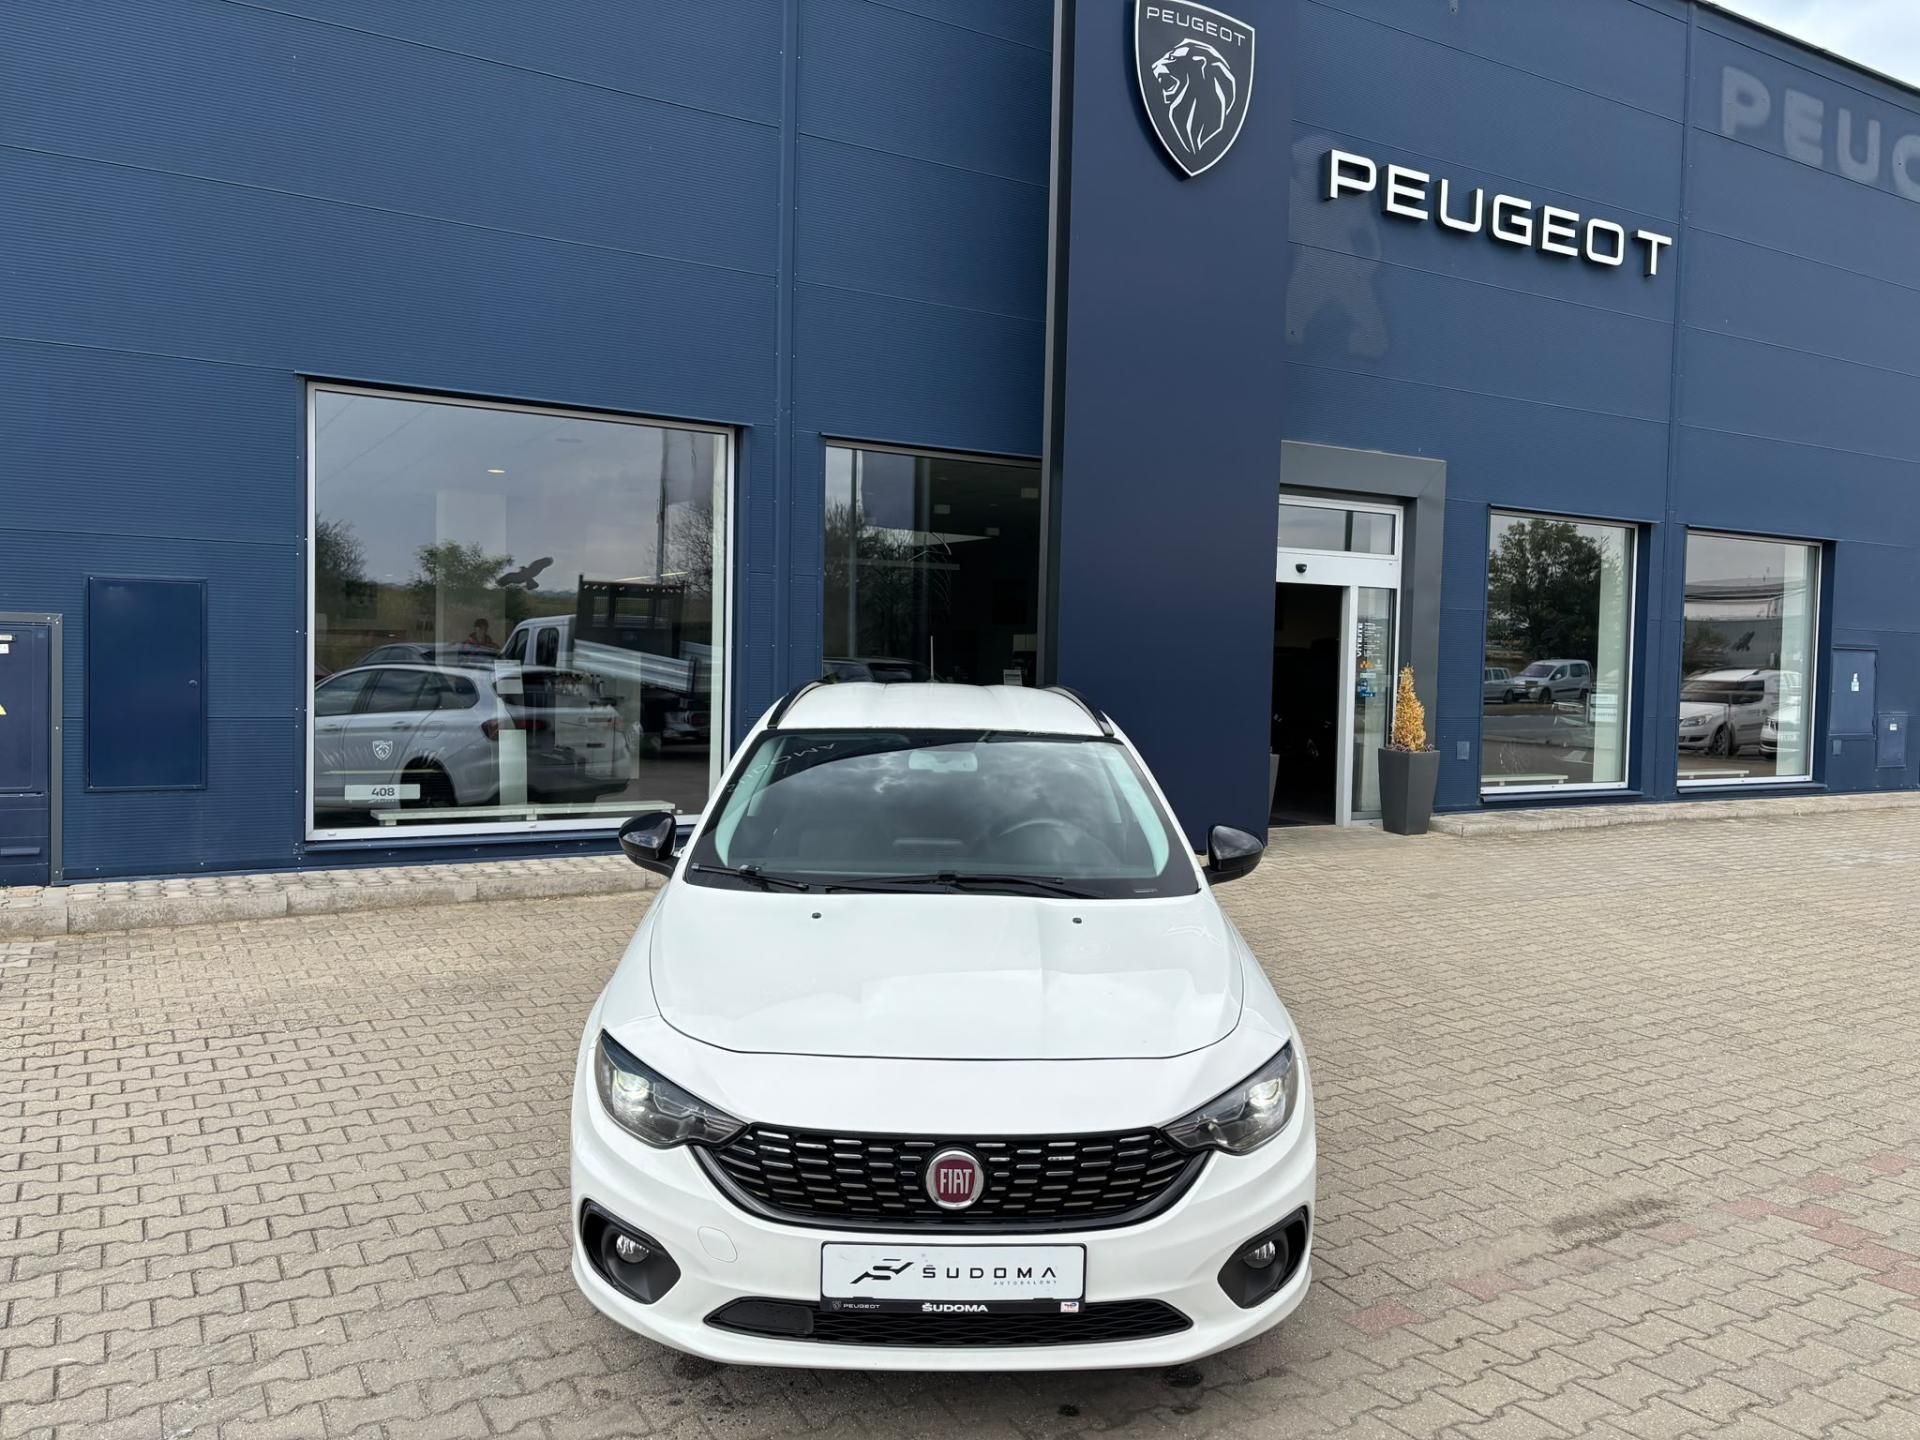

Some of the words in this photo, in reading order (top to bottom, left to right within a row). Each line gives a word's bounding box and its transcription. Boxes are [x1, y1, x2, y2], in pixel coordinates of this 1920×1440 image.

[1146, 6, 1246, 46] PEUGEOT
[1326, 148, 1673, 276] PEUGEOT
[371, 787, 396, 797] 408
[940, 1168, 973, 1195] FIAT
[922, 1264, 1057, 1279] ŠUDOMA
[921, 1302, 989, 1313] ŠUDOMA
